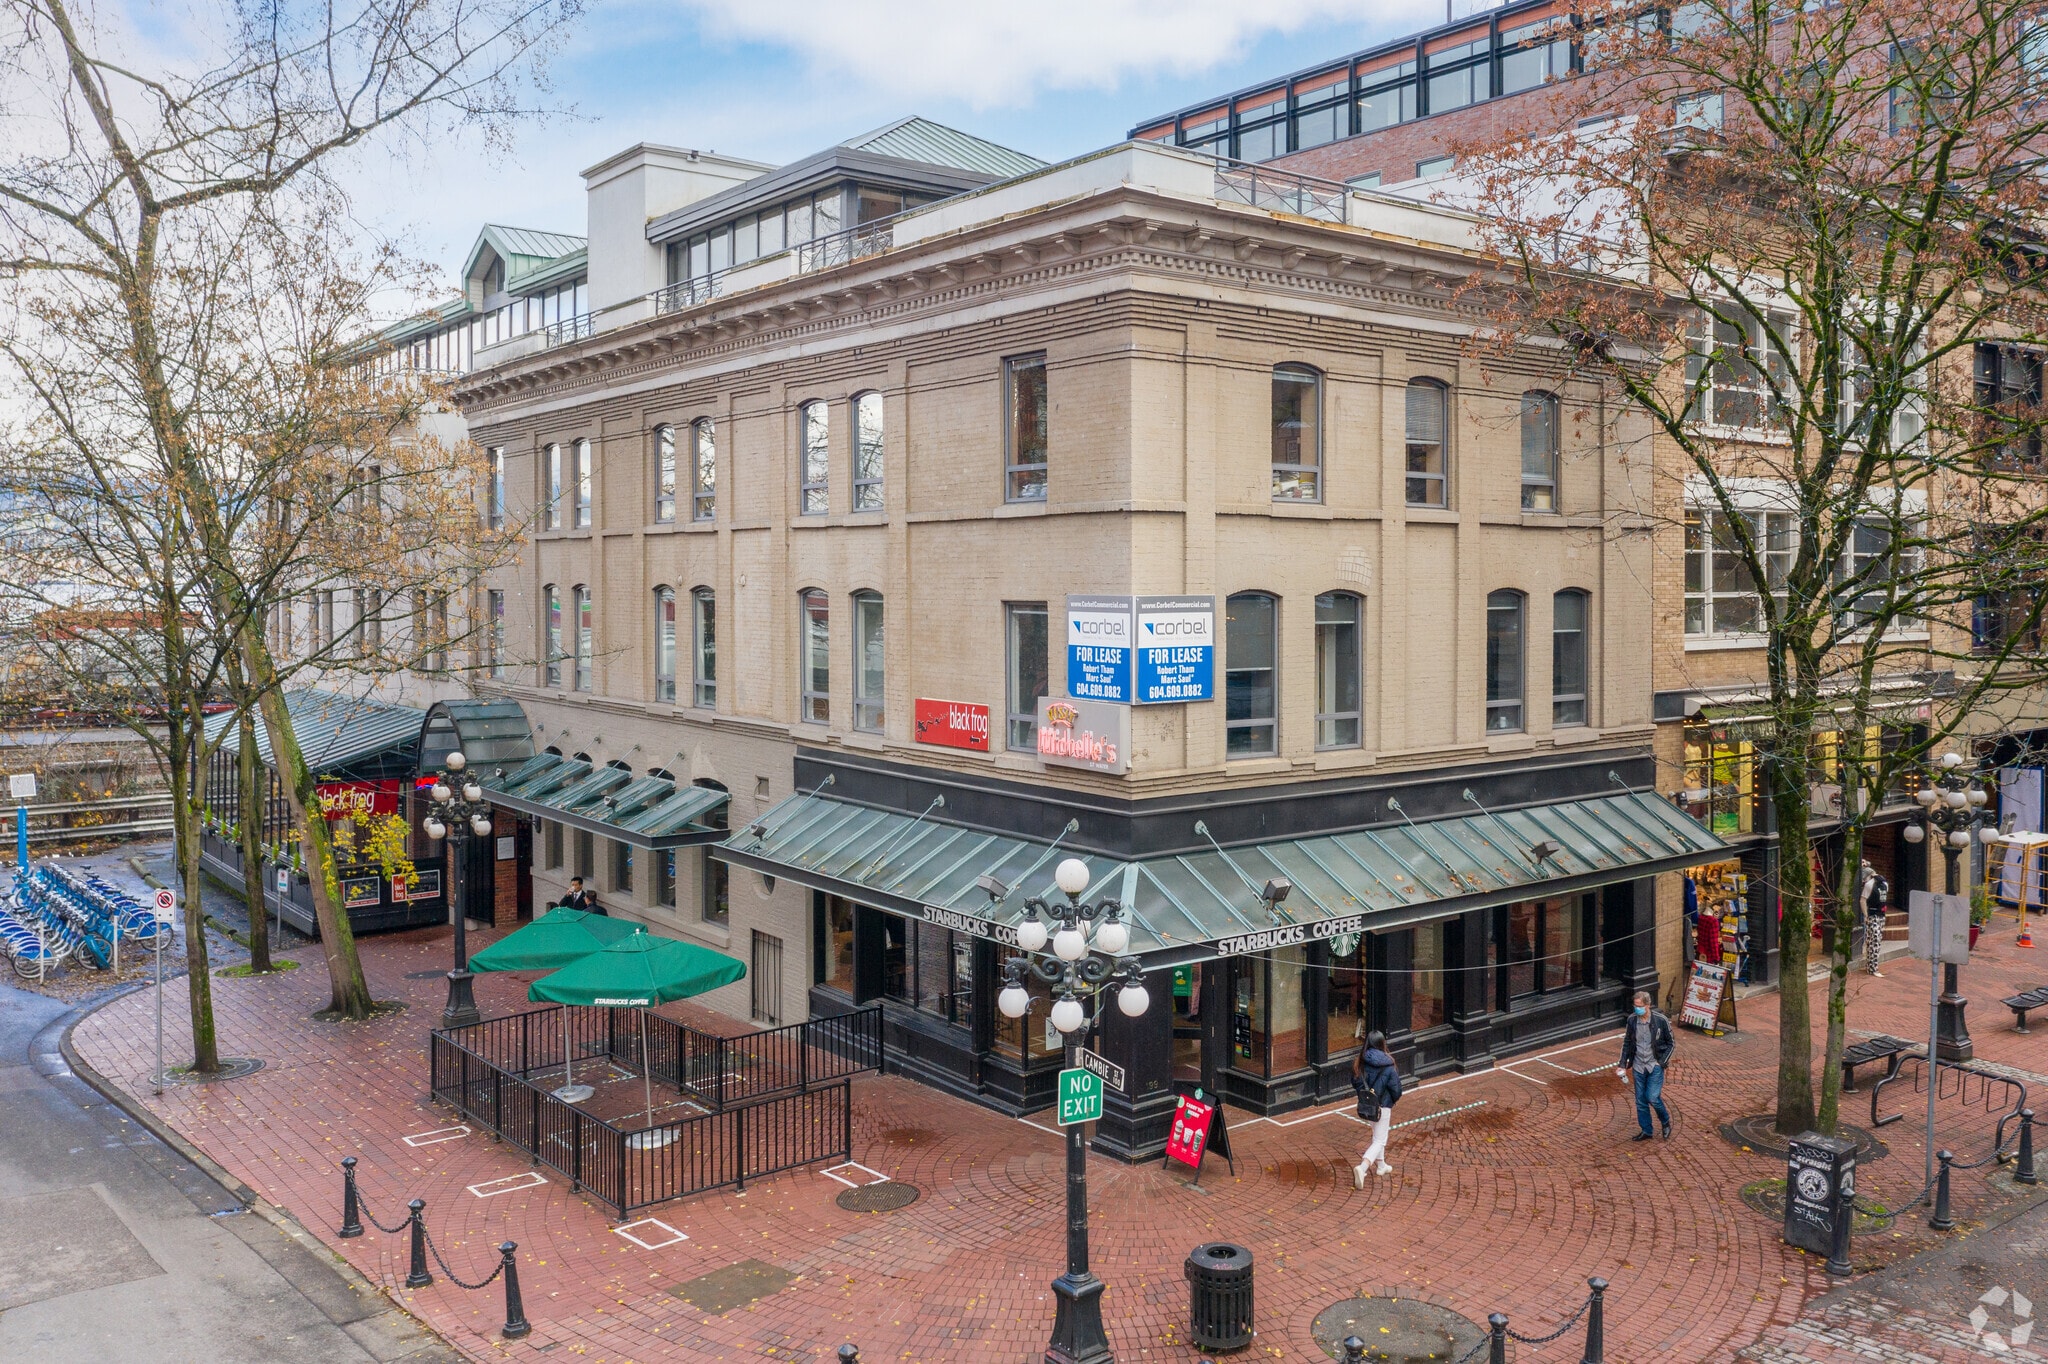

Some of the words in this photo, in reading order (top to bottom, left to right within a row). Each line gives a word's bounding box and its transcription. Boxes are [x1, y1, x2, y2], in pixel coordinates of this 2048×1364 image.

[1070, 601, 1129, 609] www.CorbelCommercial.com
[1141, 601, 1211, 609] www.CorbelCommercial.com
[1081, 618, 1126, 636] corbel
[1155, 618, 1207, 636] corbel
[1076, 646, 1092, 662] FOR
[1094, 648, 1122, 664] LEASE
[1149, 648, 1169, 664] FOR
[1171, 647, 1203, 663] LEASE
[1082, 663, 1100, 673] Robert
[1100, 665, 1115, 674] Tham
[1085, 673, 1099, 682] Marc
[1156, 666, 1178, 675] Robert
[1178, 664, 1195, 674] Tham
[1160, 675, 1177, 684] Marc
[1076, 683, 1121, 698] 604.609.0882
[1149, 684, 1202, 699] 604.609.0882
[950, 704, 970, 731] black
[970, 707, 988, 739] frog
[349, 786, 375, 813] frog
[923, 905, 989, 937] STARBUCKS
[995, 925, 1019, 945] COF
[1217, 926, 1305, 956] STARBUCKS
[1312, 915, 1362, 938] COFFEE
[1084, 1054, 1110, 1079] CAMBIE
[1070, 1074, 1092, 1094] NO
[1064, 1095, 1097, 1117] EXIT
